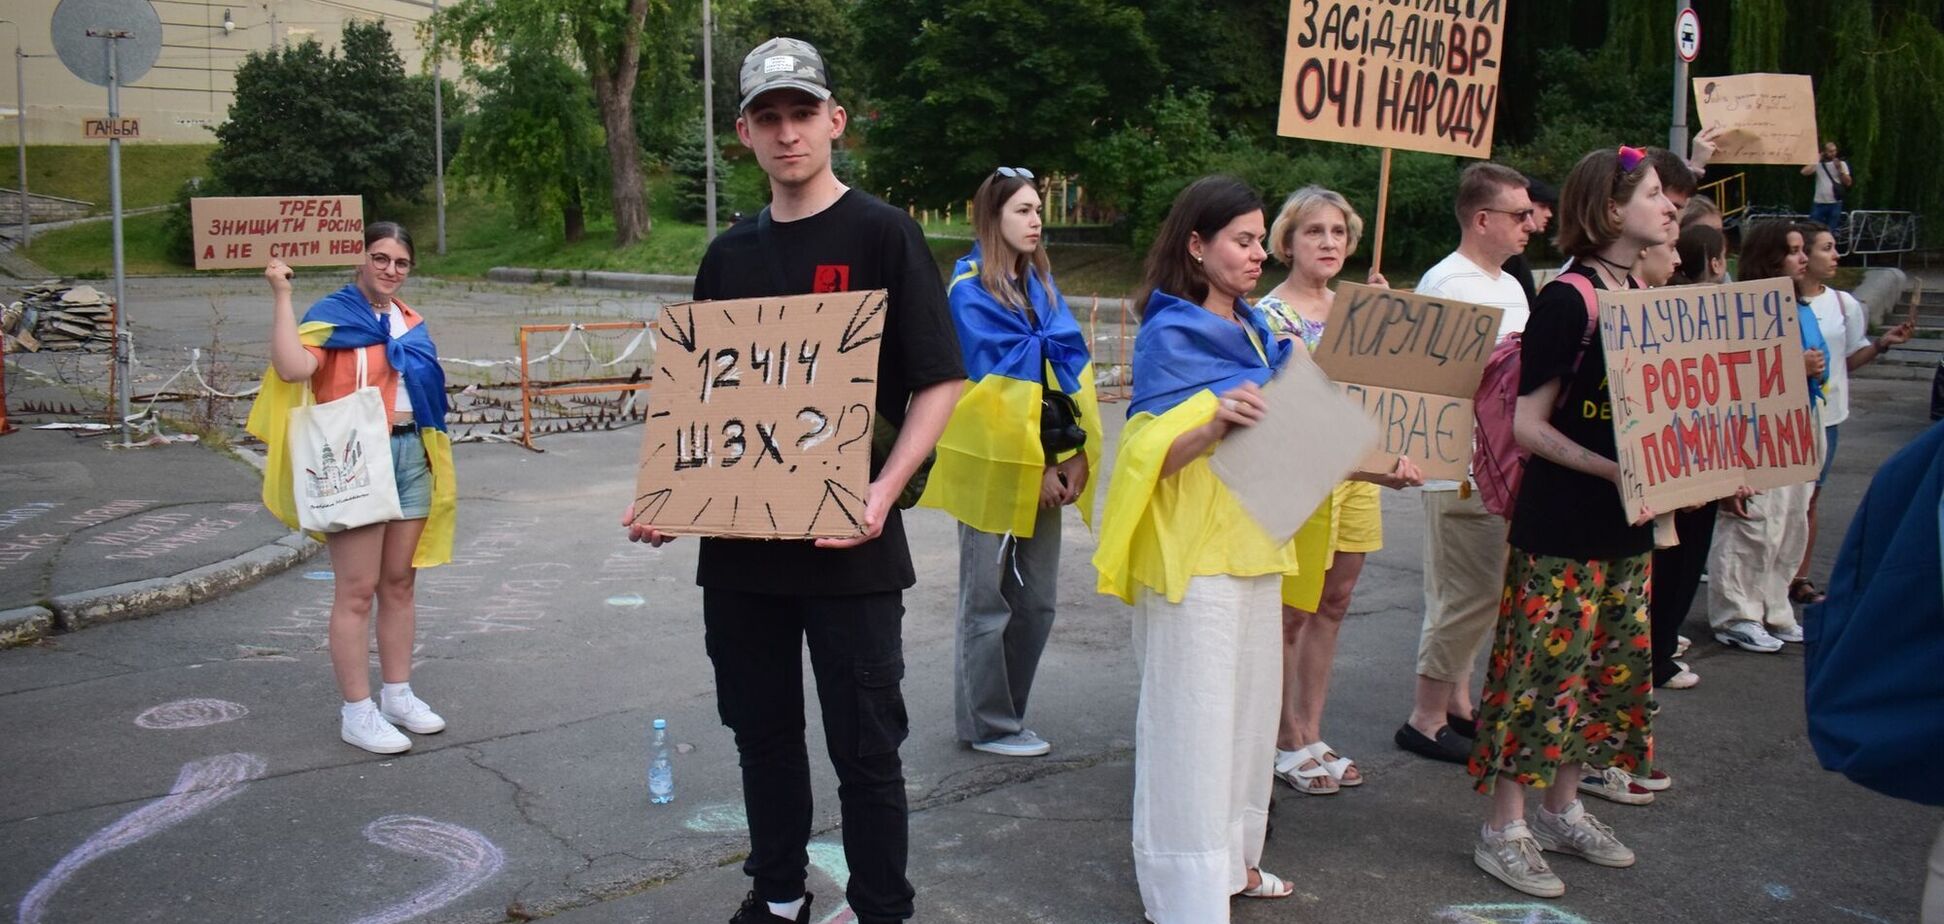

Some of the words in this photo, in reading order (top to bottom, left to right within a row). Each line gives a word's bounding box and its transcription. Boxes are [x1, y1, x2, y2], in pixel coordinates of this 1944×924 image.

[1297, 0, 1445, 70] ЗАСІДАНЬ
[86, 119, 140, 136] ГАНЬБА
[1295, 57, 1367, 129] ОЧІ
[1376, 65, 1496, 148] НАРОДУ
[208, 218, 306, 236] ЗНИЩИТИ
[279, 199, 342, 217] ТРЕБА
[203, 245, 215, 259] А
[226, 243, 252, 259] НЕ
[270, 240, 320, 258] СТАТИ
[329, 239, 364, 255] НЕЮ
[1332, 289, 1493, 366] КОРУПЦІЯ
[697, 338, 822, 404] 12414
[1641, 344, 1786, 414] РОБОТИ
[1641, 404, 1816, 487] ПОМИЛКАМИ
